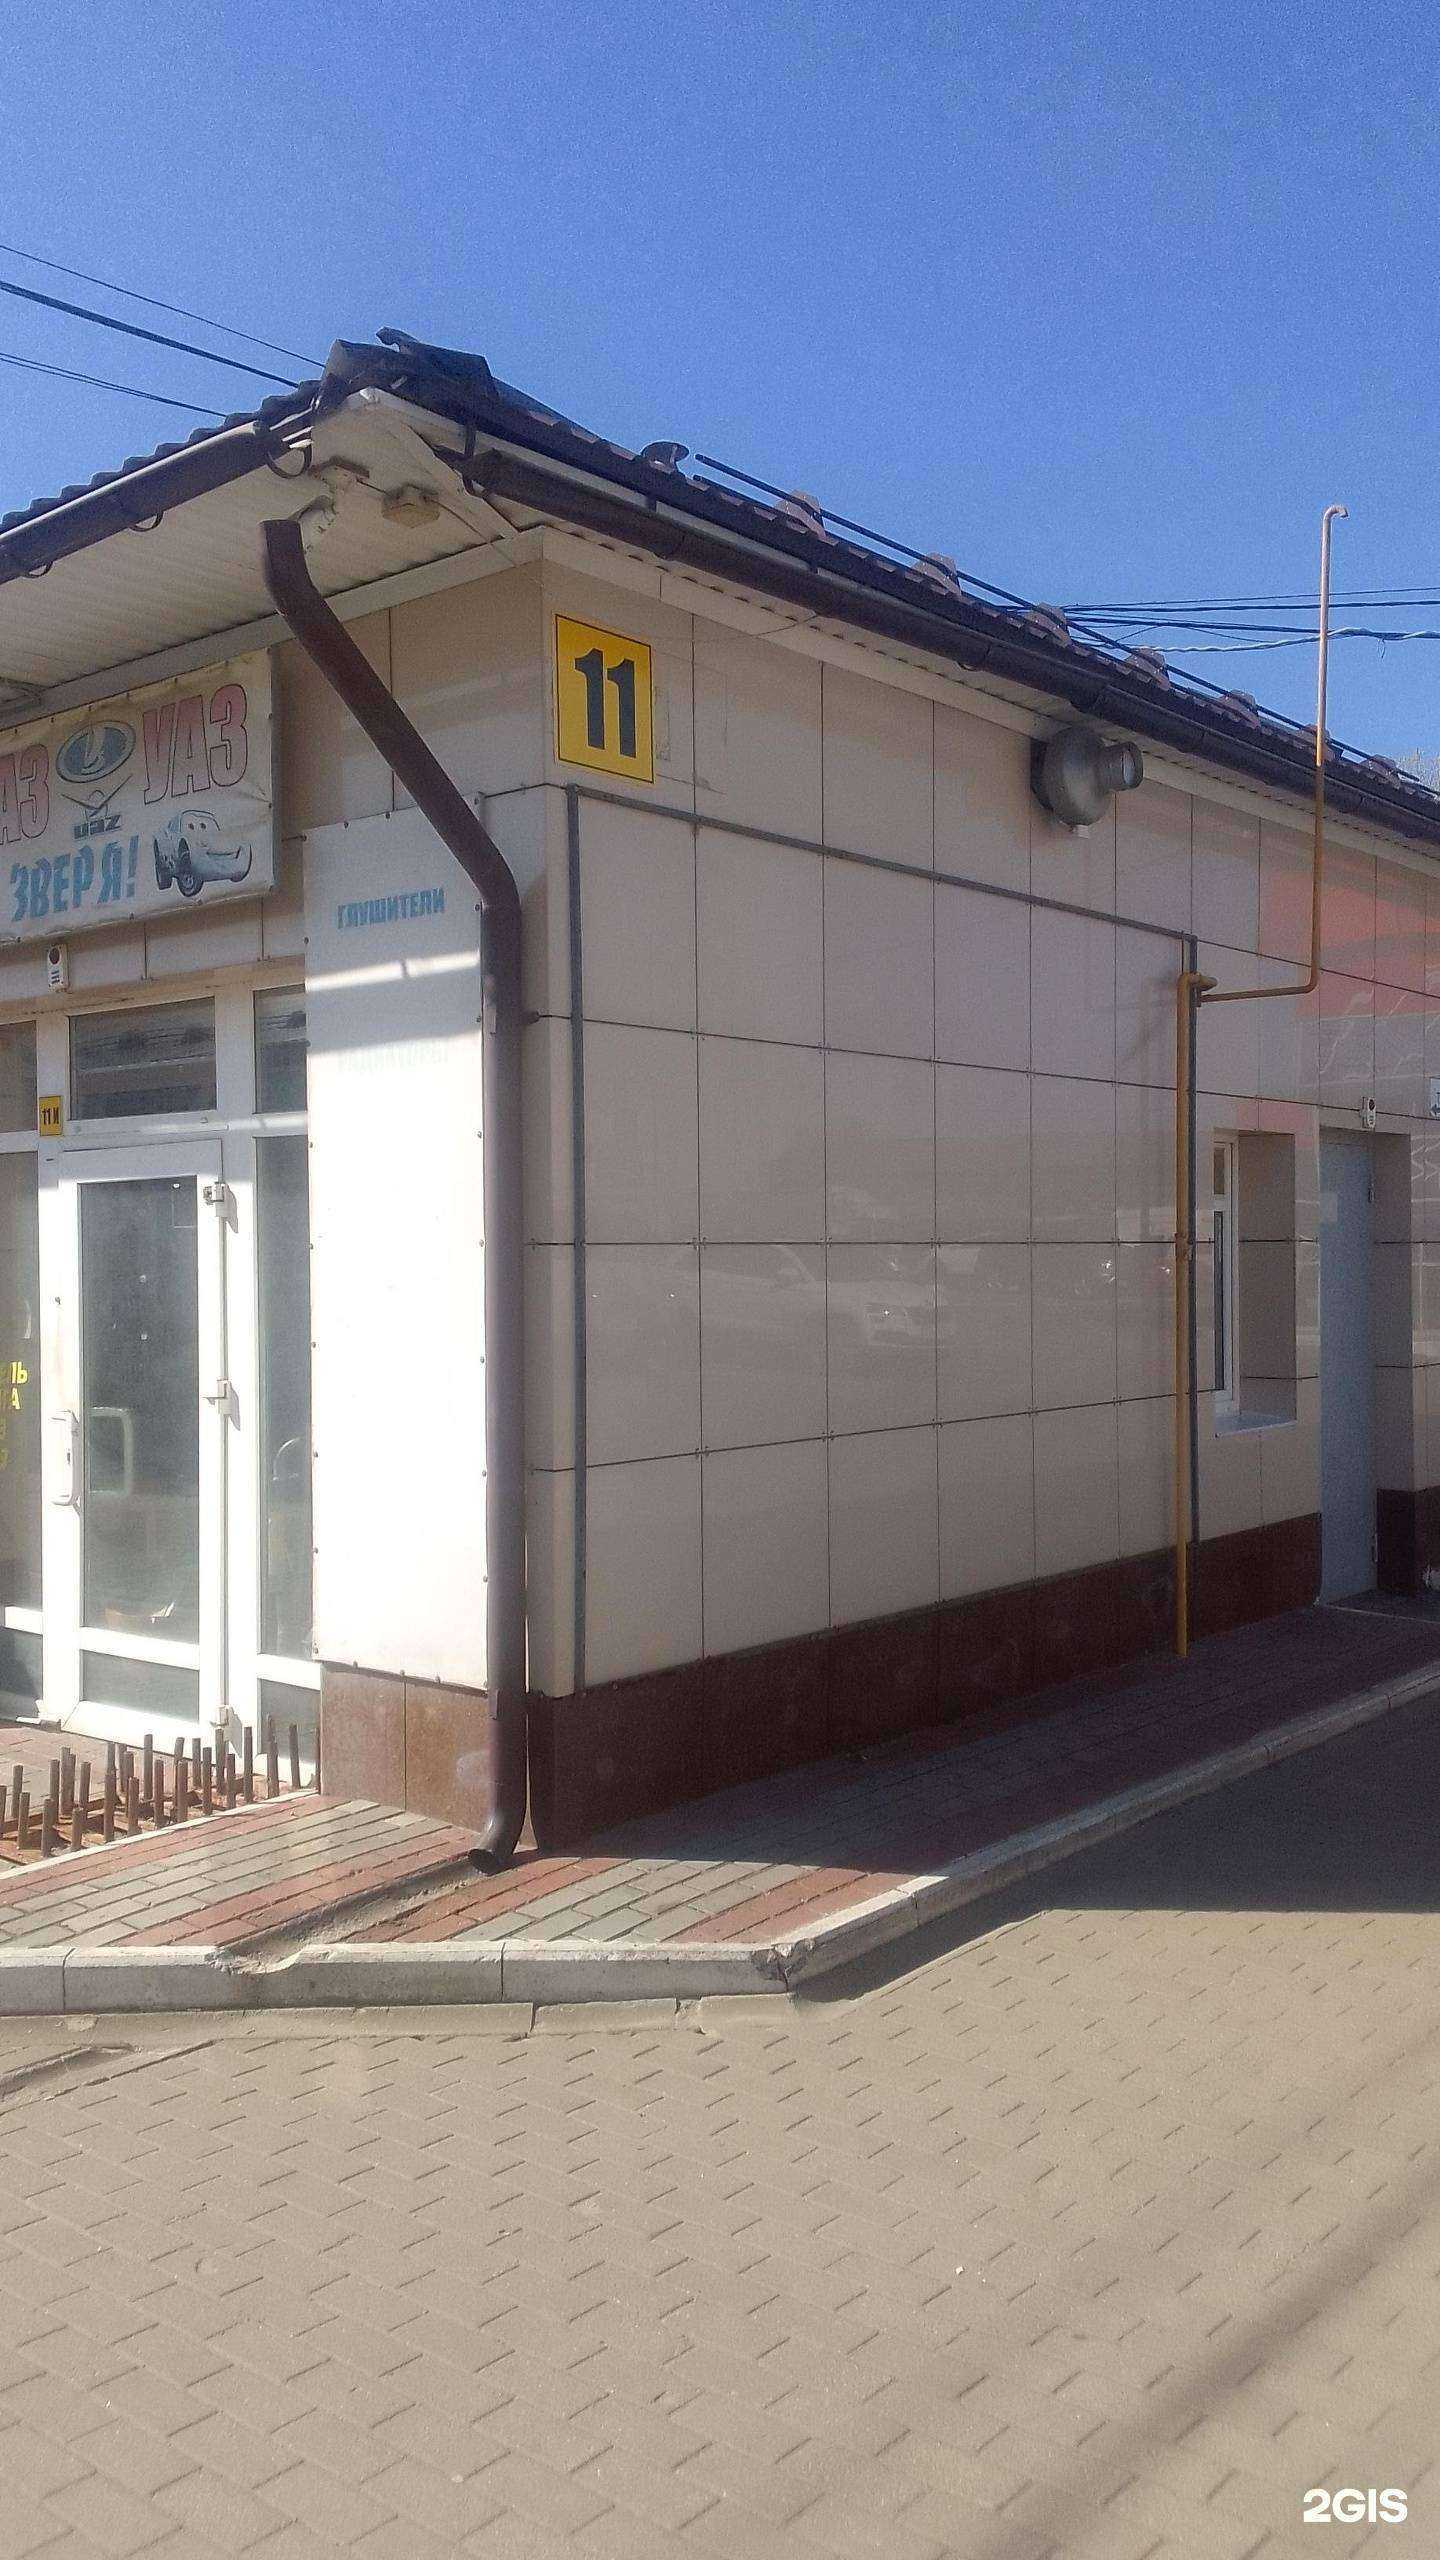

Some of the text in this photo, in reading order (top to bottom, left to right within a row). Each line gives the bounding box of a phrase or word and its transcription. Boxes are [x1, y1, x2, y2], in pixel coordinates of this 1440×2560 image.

[143, 683, 248, 805] УАЗ
[574, 648, 636, 759] 11
[9, 835, 139, 922] ЗВЕРЯ!
[337, 887, 445, 929] ГЛУШИТЕЛИ
